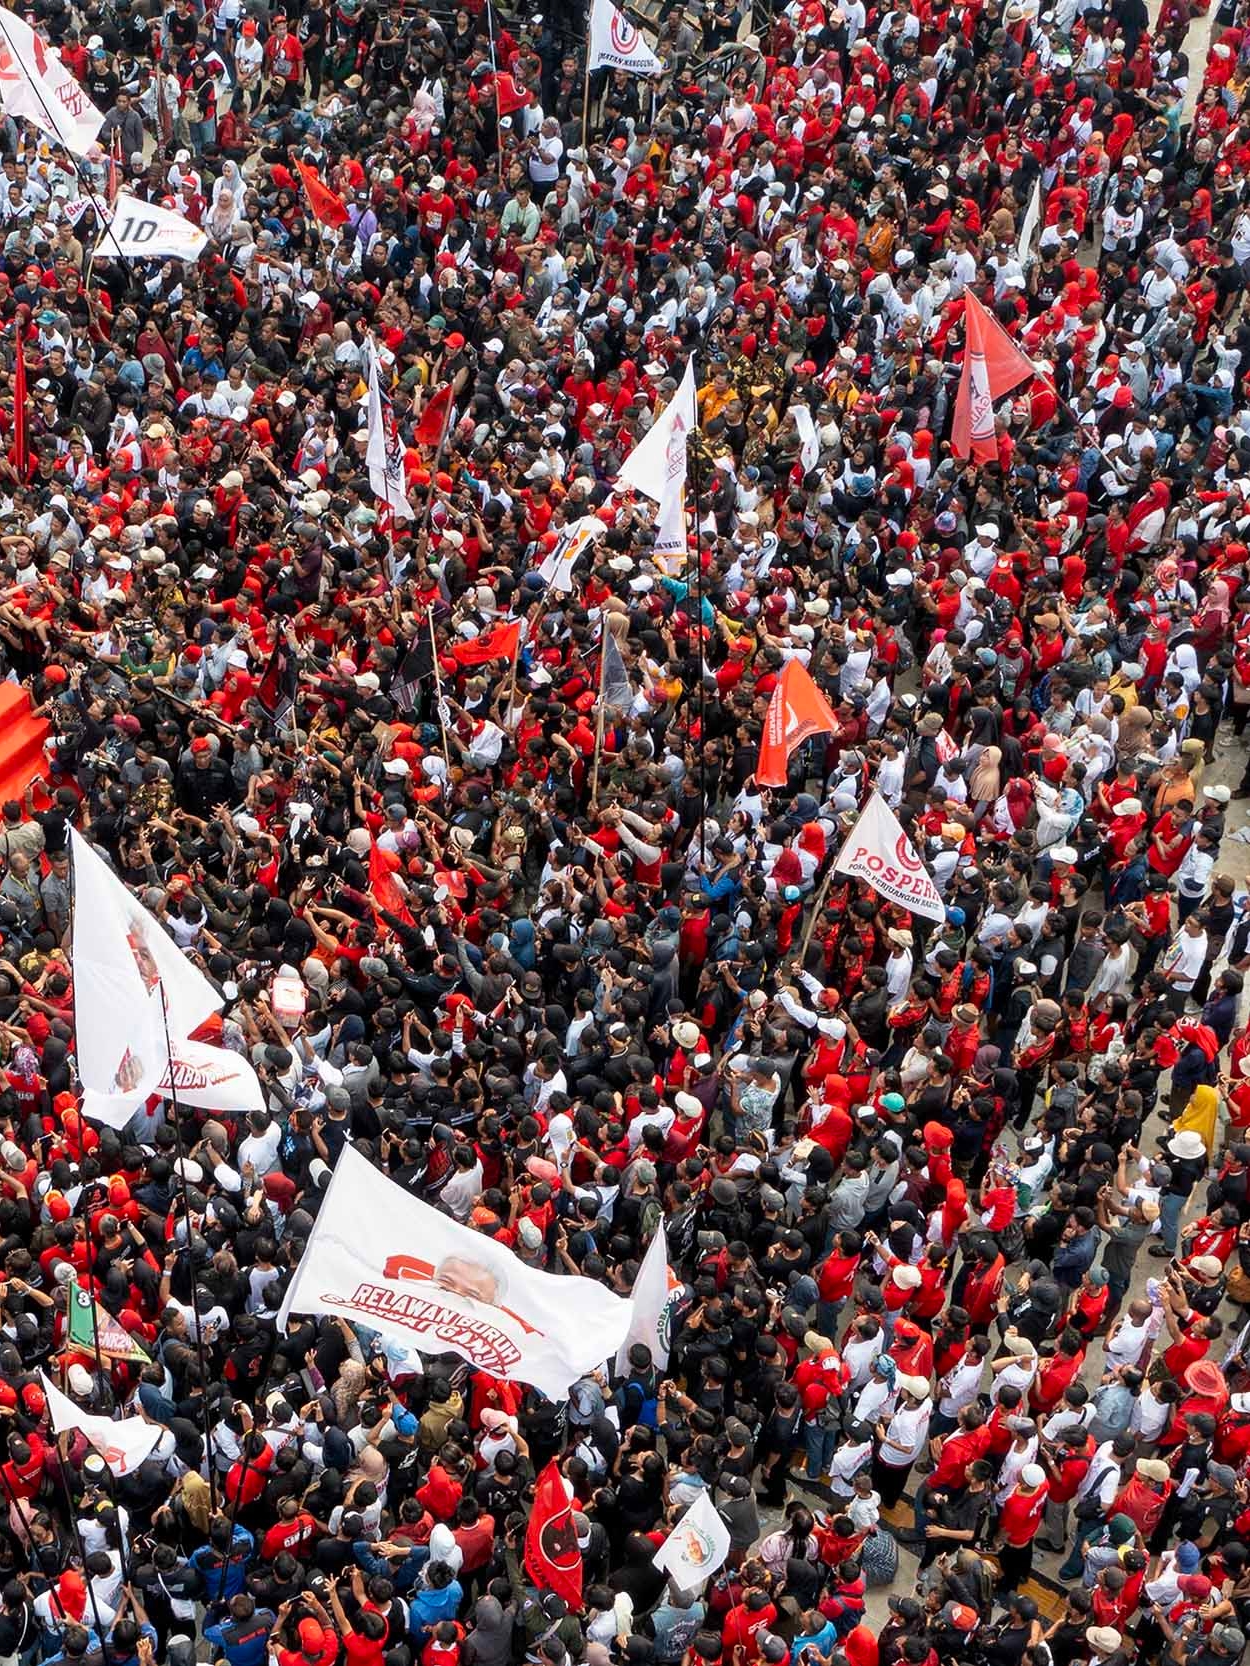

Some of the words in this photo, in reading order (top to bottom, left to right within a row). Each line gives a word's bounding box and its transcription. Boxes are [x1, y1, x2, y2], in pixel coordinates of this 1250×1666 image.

[871, 875, 920, 905] PERJUANGAN
[351, 1283, 456, 1325] RELAWAN
[455, 1315, 522, 1370] BURUH
